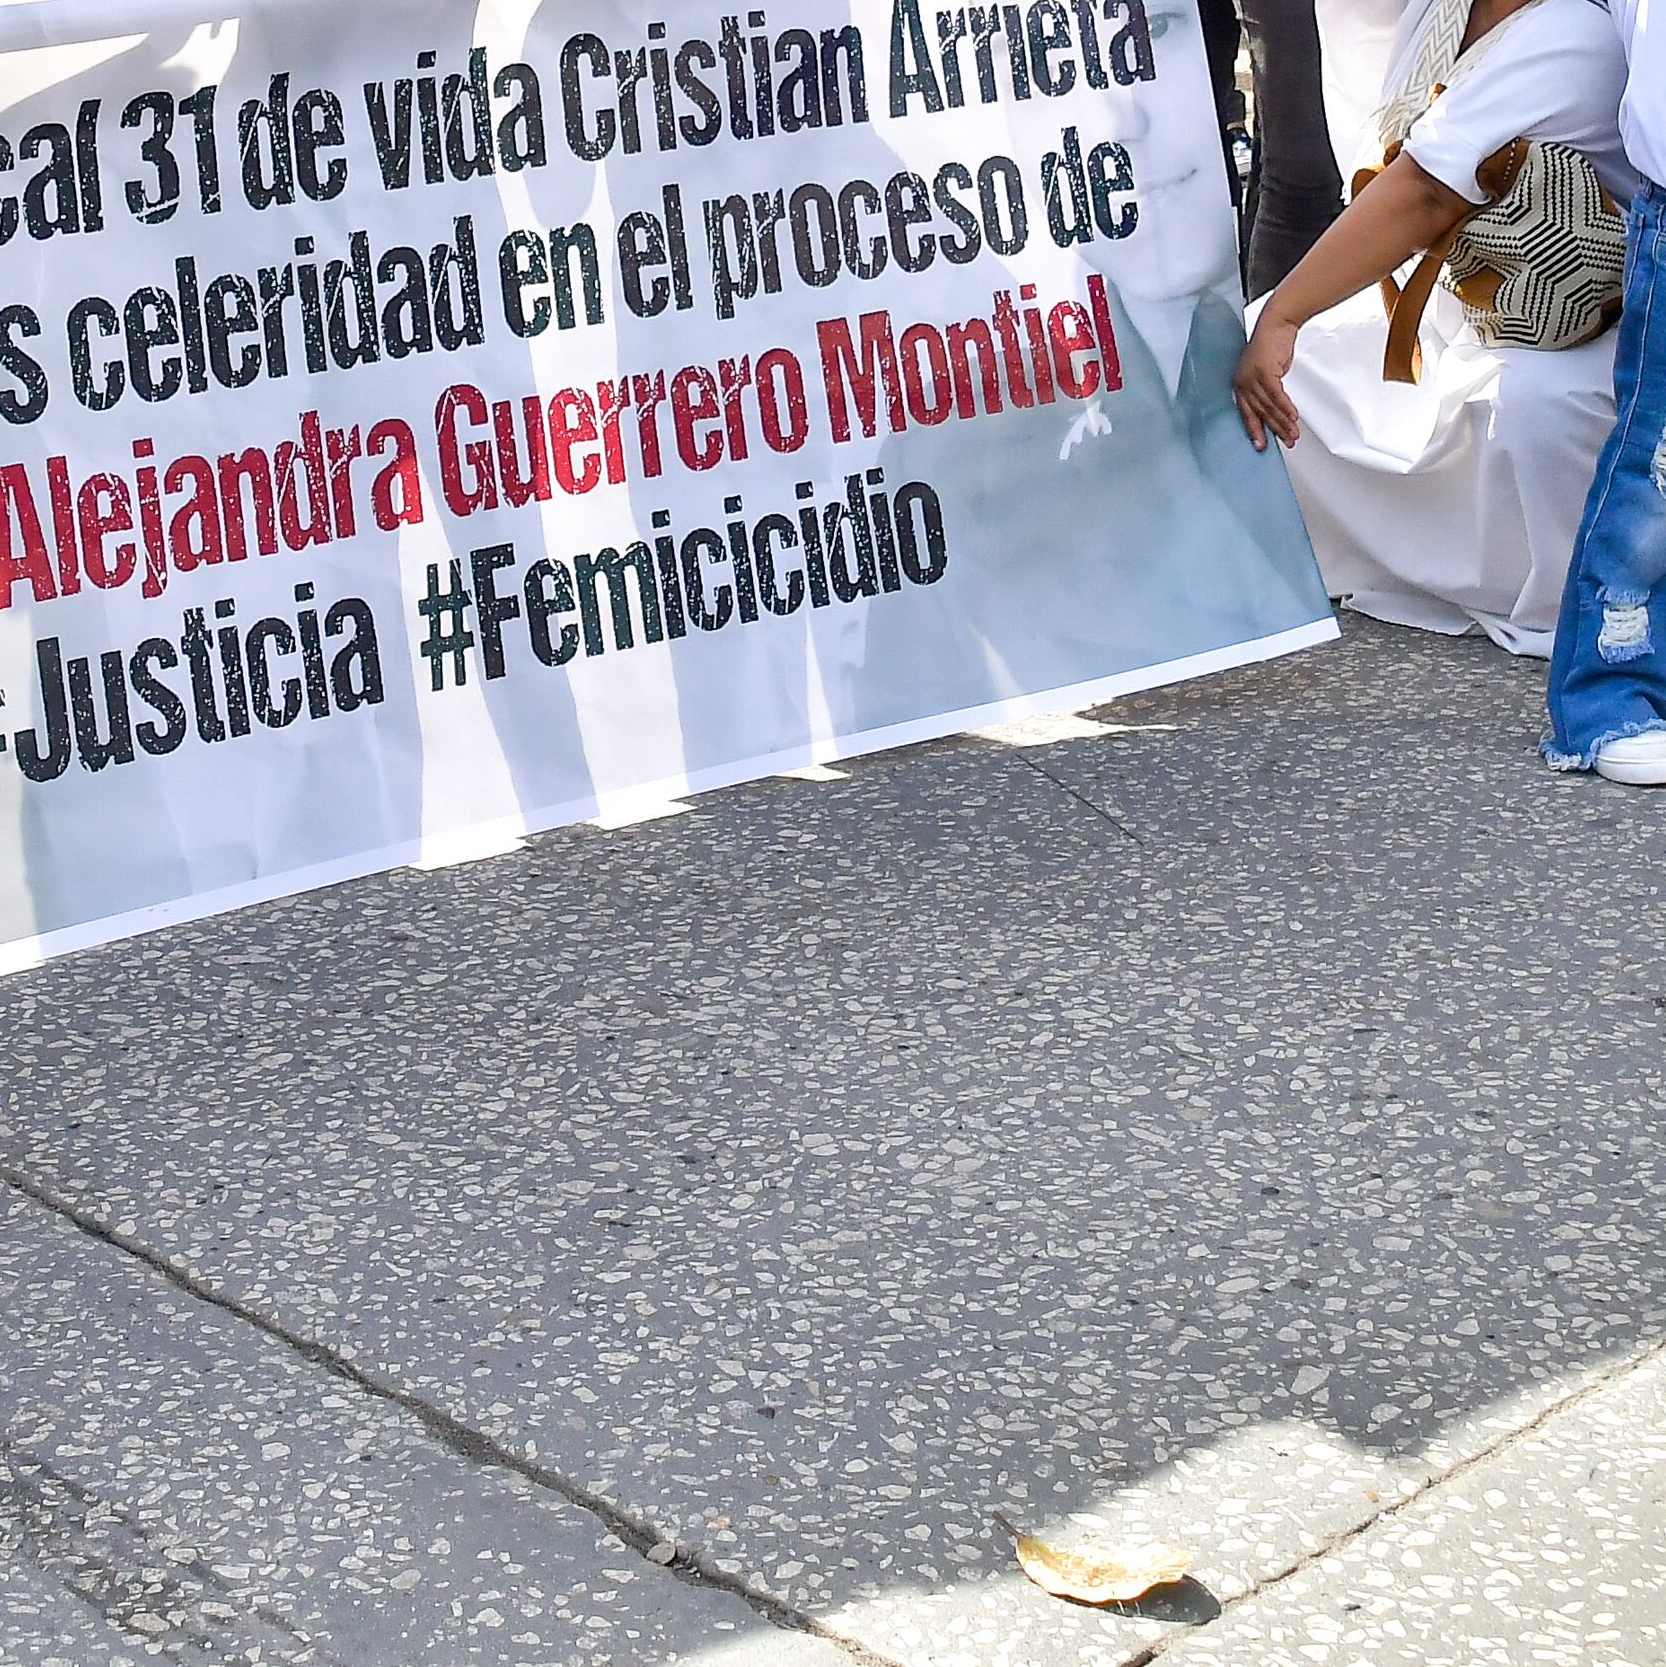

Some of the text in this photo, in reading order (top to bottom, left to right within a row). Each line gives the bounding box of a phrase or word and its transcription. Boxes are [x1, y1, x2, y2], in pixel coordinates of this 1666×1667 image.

[120, 82, 222, 227] 31
[237, 70, 349, 211] de
[362, 45, 547, 191] vida
[559, 9, 871, 163] Cristian
[68, 214, 486, 413] celeridad
[499, 215, 606, 339] en
[617, 182, 695, 320] el
[703, 152, 1031, 322] proceso
[1039, 125, 1139, 249] de
[435, 344, 808, 519] Guerrero
[815, 273, 1126, 445] Montiel
[417, 464, 953, 694] #Femicicidio
